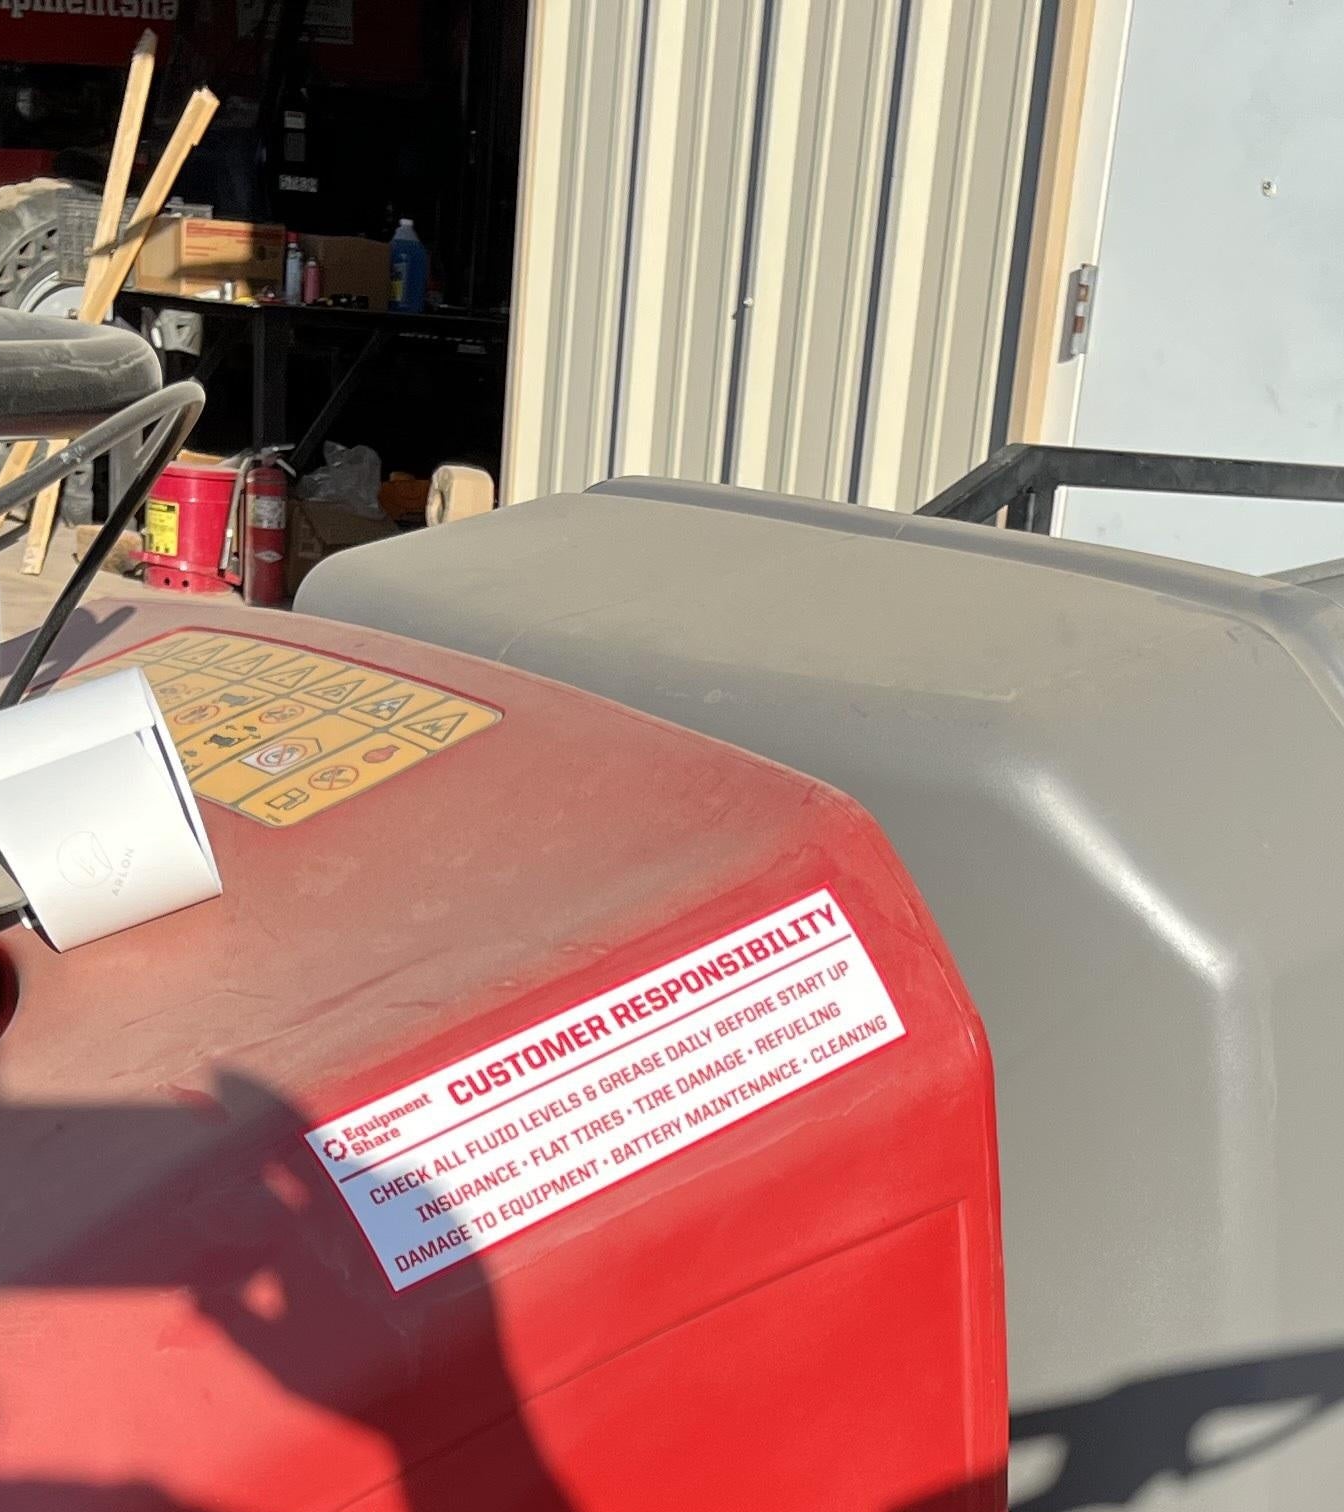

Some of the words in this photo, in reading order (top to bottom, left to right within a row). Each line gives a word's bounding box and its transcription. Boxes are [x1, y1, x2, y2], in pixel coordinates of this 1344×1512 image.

[368, 1163, 430, 1206] CHECK
[433, 1152, 467, 1177] ALL
[464, 1122, 520, 1160] FLUID
[522, 1092, 582, 1133] LEVELS
[583, 1084, 598, 1101] &
[598, 1051, 666, 1096] GREASE
[663, 1027, 715, 1063] DAILY
[713, 996, 779, 1038] BEFORE
[776, 970, 832, 1006] START
[828, 959, 851, 982] UP
[446, 1014, 613, 1106] CUSTOMER
[608, 903, 838, 1030] RESPONSIBILITY
[340, 1091, 433, 1142] Equipment
[351, 1124, 401, 1157] Share
[393, 1224, 473, 1274] DAMAGE
[473, 1211, 499, 1234] TO
[500, 1158, 602, 1223] EQUIPMENT
[610, 1117, 684, 1167] BATTERY
[684, 1057, 803, 1129] MAINTENANCE
[808, 1014, 889, 1065] CLEANING
[414, 1160, 522, 1224] INSURANCE
[528, 1135, 570, 1167] FLAT
[571, 1109, 626, 1146] TIRES
[632, 1083, 681, 1117] TIRE
[675, 1048, 748, 1096] DAMAGE
[754, 1001, 843, 1055] REFUELING
